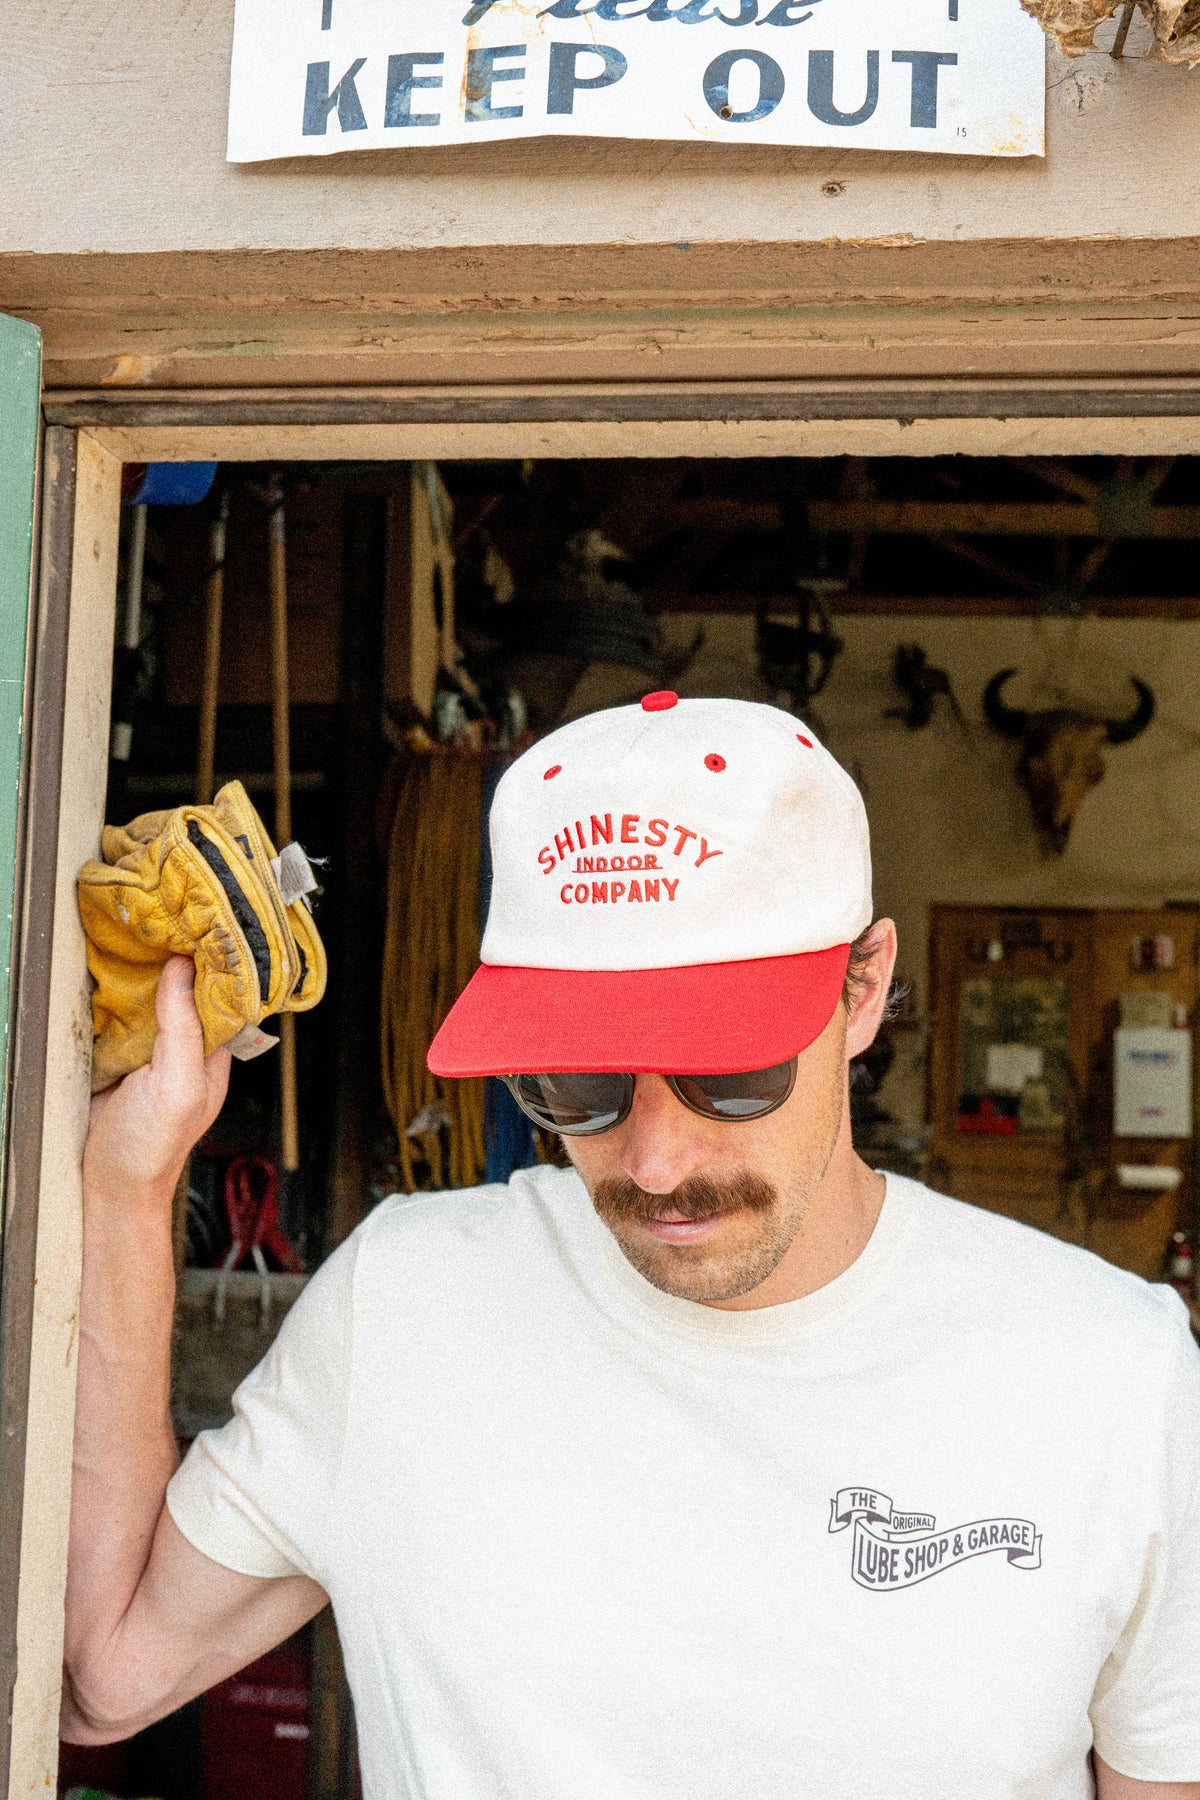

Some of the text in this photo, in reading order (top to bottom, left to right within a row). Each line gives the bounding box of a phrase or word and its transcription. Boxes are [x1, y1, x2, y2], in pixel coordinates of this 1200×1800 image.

[302, 41, 958, 136] KEEP OUT
[538, 813, 723, 874] SHINESTY
[576, 854, 658, 872] INDOOR
[560, 878, 680, 904] COMPANY
[850, 1492, 877, 1510] THE
[893, 1516, 932, 1530] ORIGINAL
[857, 1524, 1030, 1583] LUBE SHOP & GARAGE
